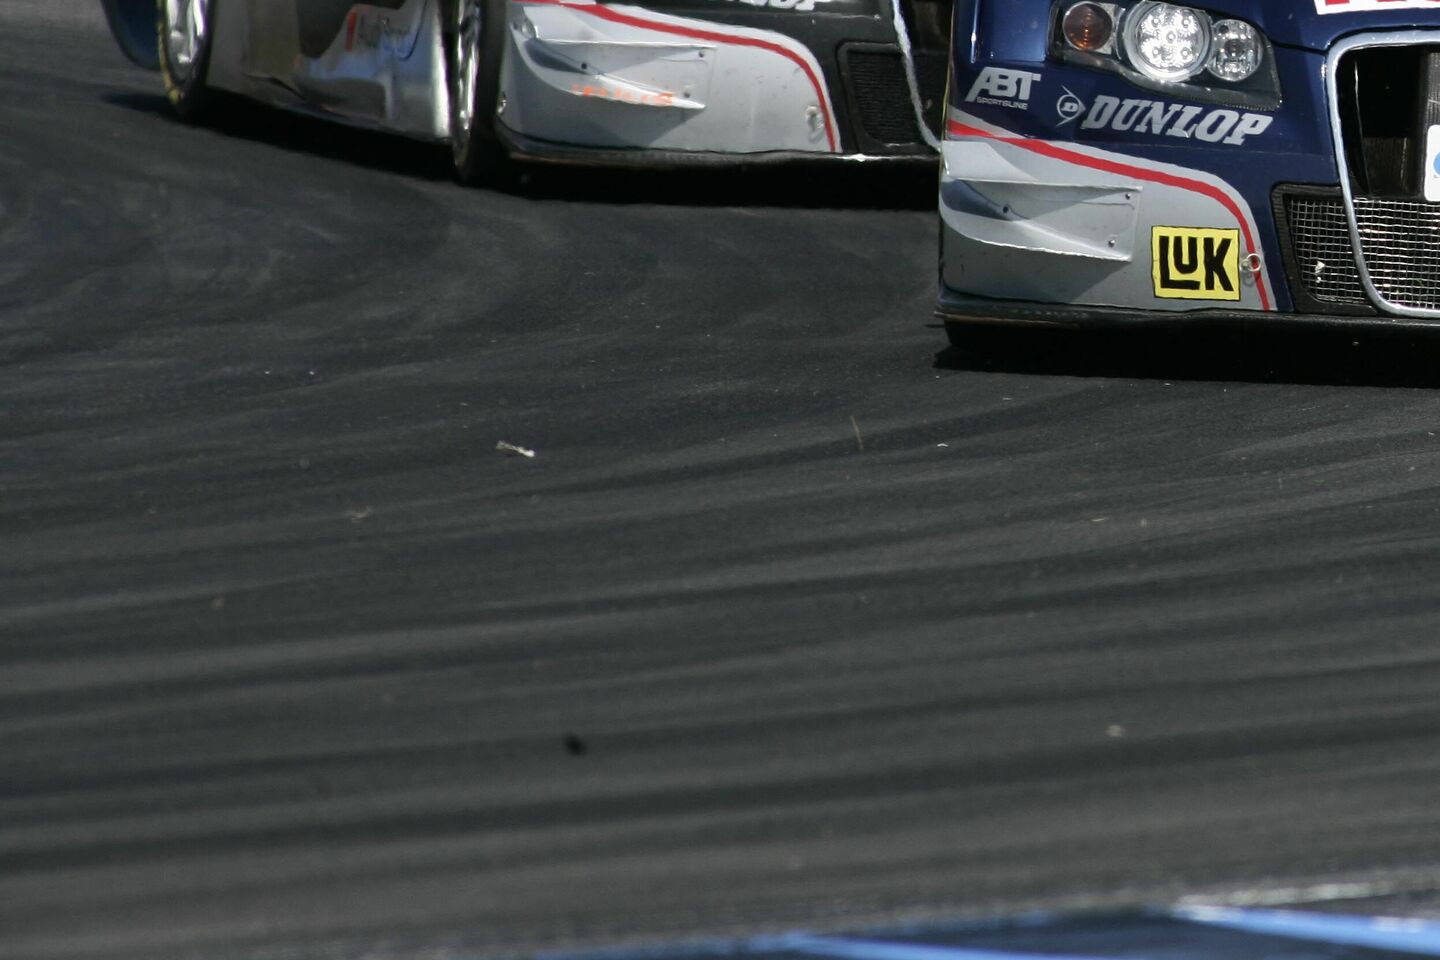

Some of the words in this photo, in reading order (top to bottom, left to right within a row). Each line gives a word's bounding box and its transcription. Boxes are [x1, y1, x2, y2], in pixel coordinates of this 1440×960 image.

[964, 66, 1042, 103] ABT
[976, 96, 1028, 111] SPORTSLINE
[1081, 95, 1274, 146] DUNLOP
